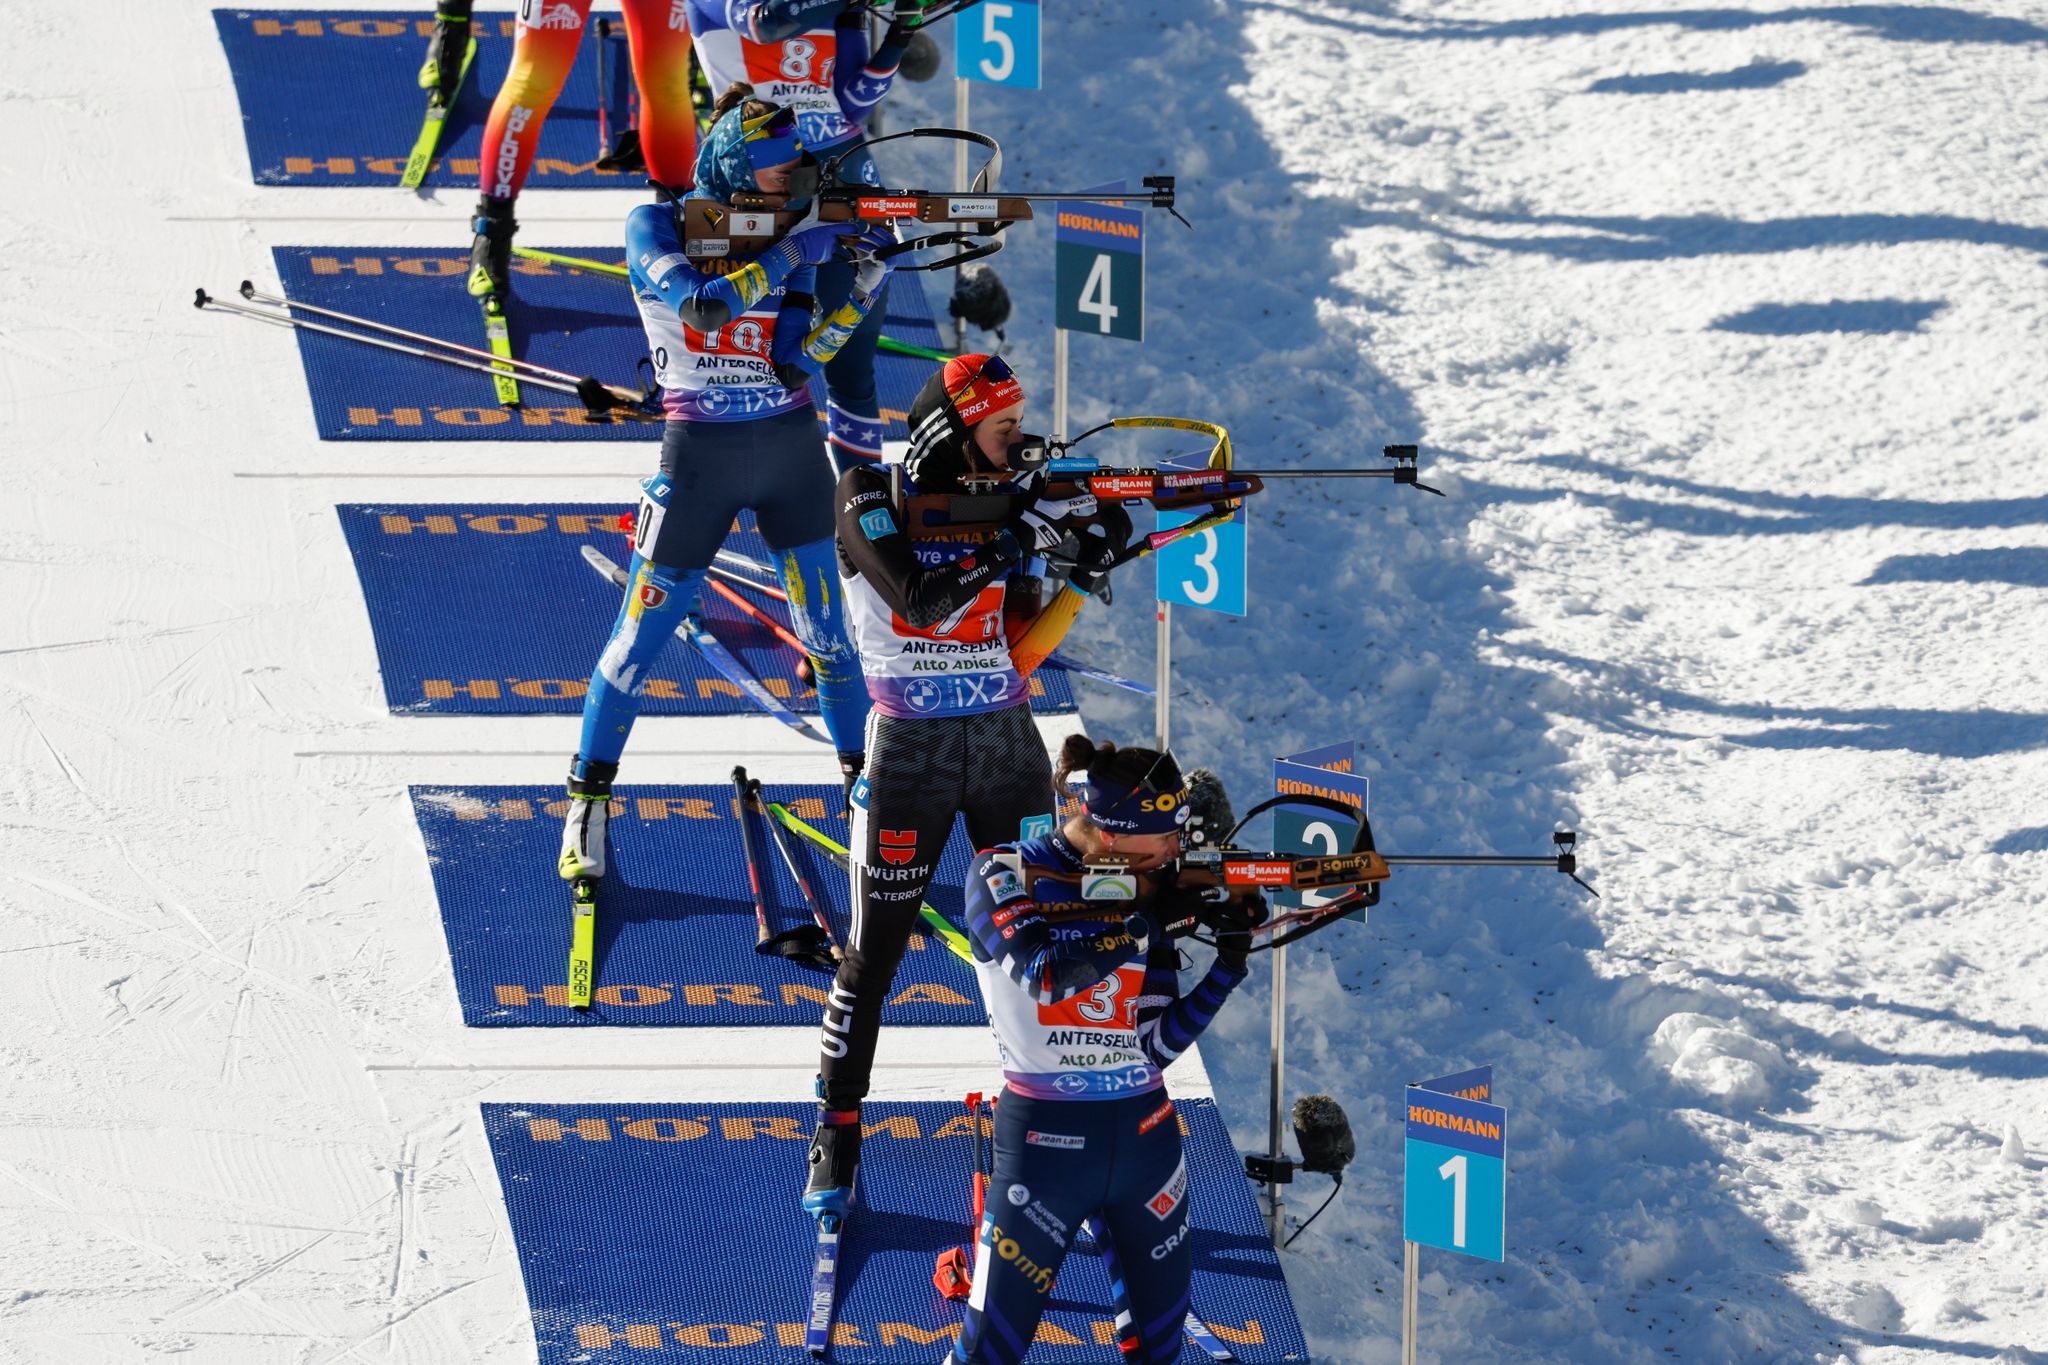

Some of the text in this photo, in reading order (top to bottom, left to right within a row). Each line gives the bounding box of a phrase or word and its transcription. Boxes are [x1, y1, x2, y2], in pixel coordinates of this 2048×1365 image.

[979, 3, 1015, 81] 5
[779, 39, 816, 80] 8
[494, 104, 534, 198] MOLDOVA
[861, 200, 917, 212] VIESSMANN
[1058, 212, 1139, 239] HÖRMANN
[1078, 254, 1118, 333] 4
[1094, 479, 1152, 491] VIESSMANN
[1181, 525, 1219, 604] 3
[902, 639, 1003, 654] ANTERSELVA
[912, 655, 1000, 671] ALTO ADIGE
[955, 673, 1009, 708] iX2
[1277, 778, 1363, 810] HÖRMANN
[1052, 838, 1081, 865] CRAFT
[1302, 821, 1339, 908] 2
[1323, 856, 1370, 873] somfy
[866, 864, 929, 882] WÜRTH
[1227, 864, 1290, 879] VIESSMANN
[883, 885, 925, 901] TERREX
[1050, 928, 1084, 942] ore
[574, 958, 589, 997] FISCHER
[1076, 972, 1122, 1023] 3
[1059, 1054, 1097, 1067] ALTO
[1408, 1105, 1501, 1141] HÖRMANN
[1438, 1154, 1467, 1249] 1
[991, 1225, 1055, 1295] somfy
[810, 1291, 832, 1331] SALOMON
